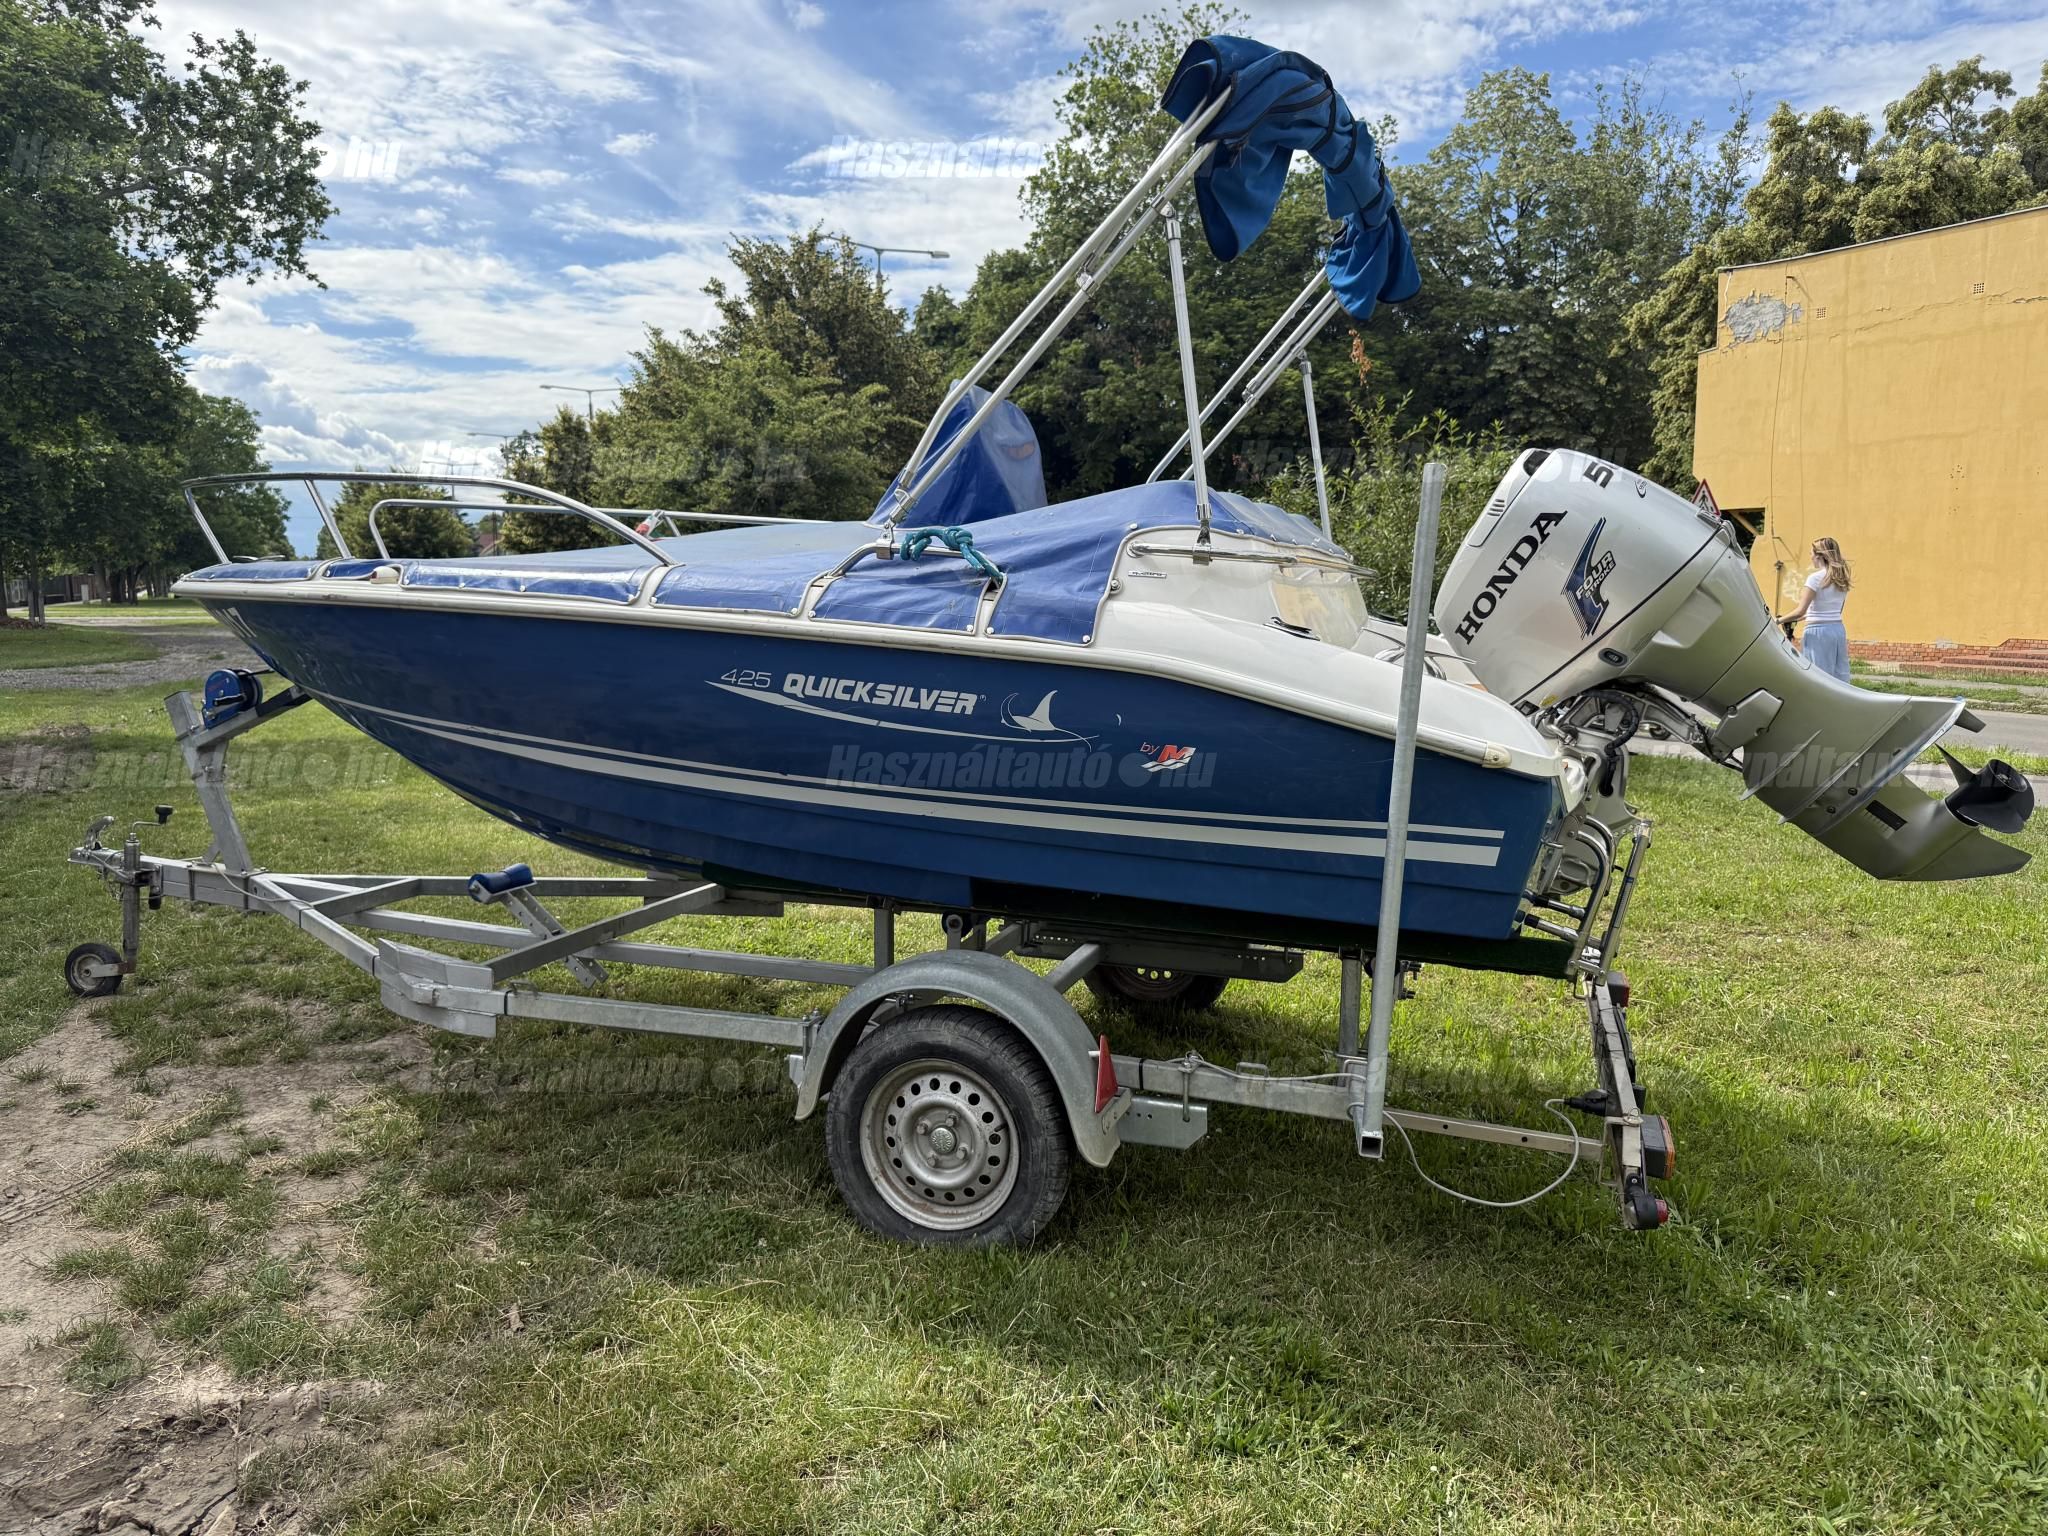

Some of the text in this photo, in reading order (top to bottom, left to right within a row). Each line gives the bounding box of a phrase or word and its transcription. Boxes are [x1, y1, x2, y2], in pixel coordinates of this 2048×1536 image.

[1454, 510, 1568, 645] HONDA
[1576, 552, 1613, 600] FOUR
[1585, 560, 1615, 598] STROKE
[720, 668, 978, 715] 425 QUICKSILVER
[1140, 741, 1160, 755] by
